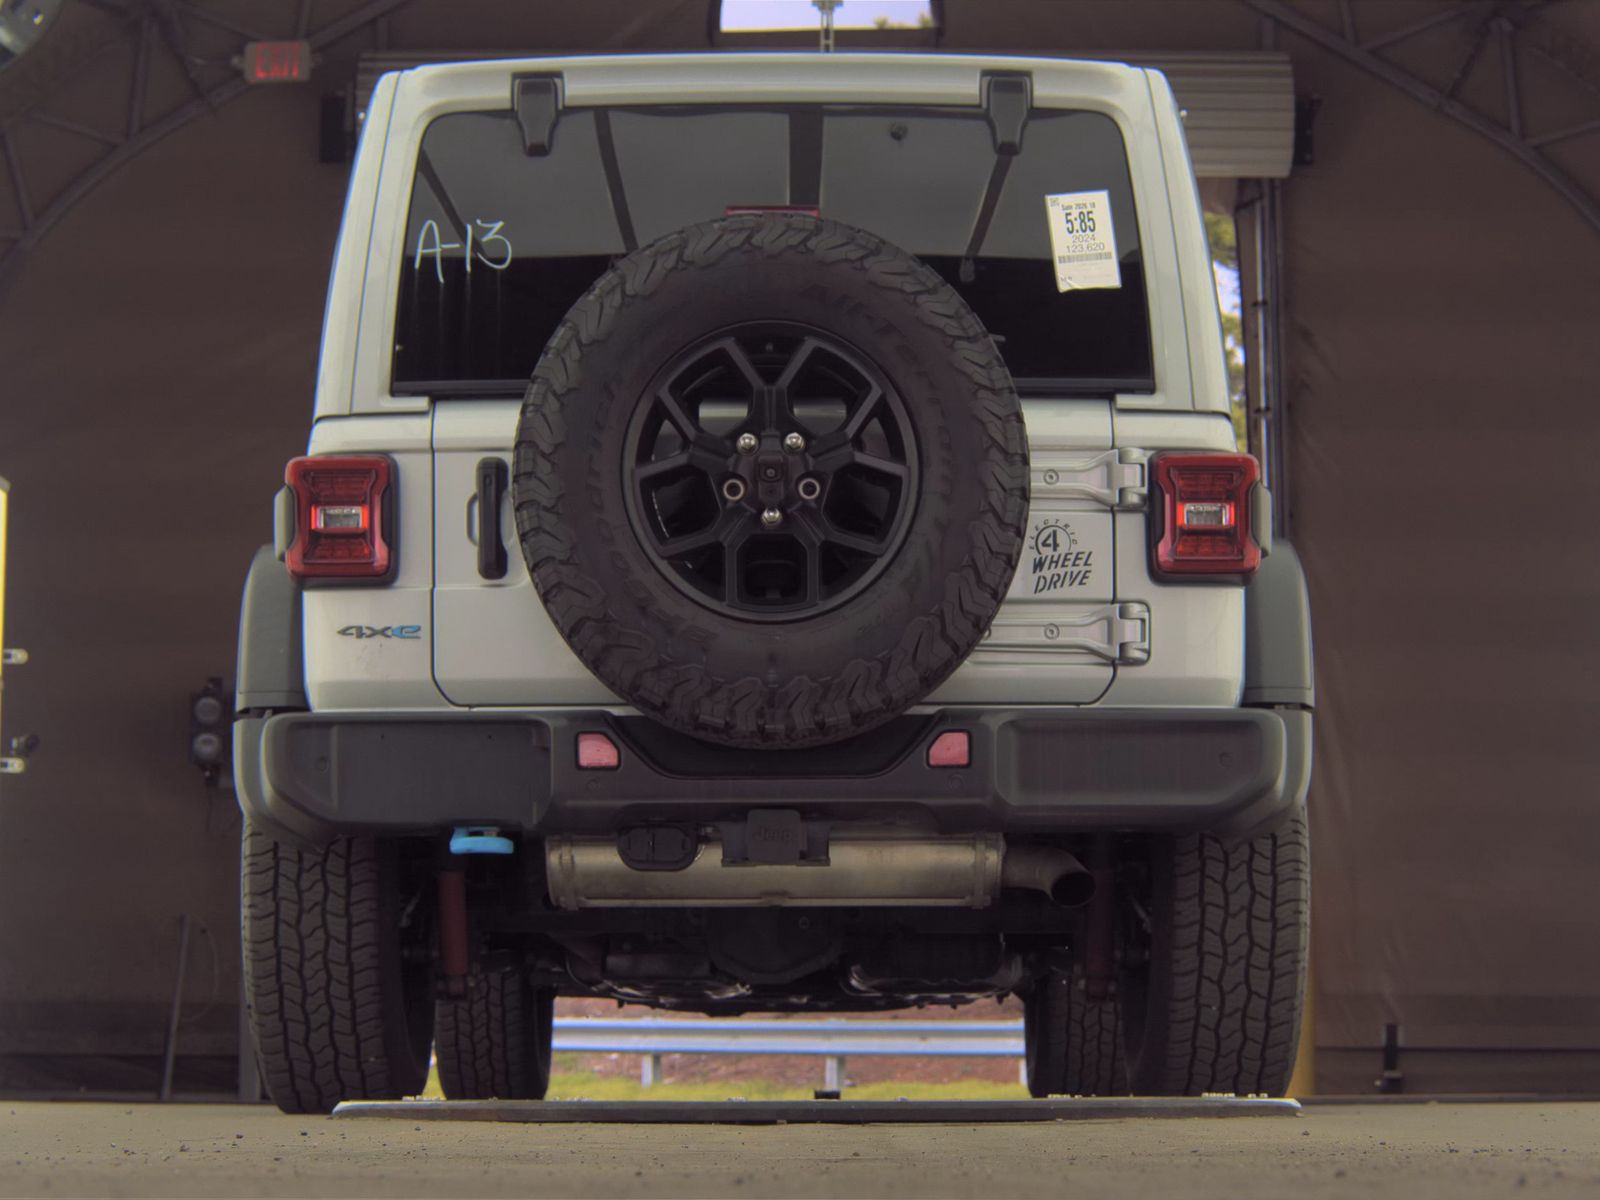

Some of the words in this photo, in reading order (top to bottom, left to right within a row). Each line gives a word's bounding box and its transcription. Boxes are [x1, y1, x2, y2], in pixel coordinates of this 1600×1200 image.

[256, 43, 303, 79] EXIT
[1065, 210, 1096, 234] 5:85
[1071, 234, 1096, 244] 2024
[414, 219, 512, 284] A-13
[1041, 529, 1060, 552] 4
[1032, 551, 1093, 574] WHEEL
[1033, 570, 1092, 594] DRIVE
